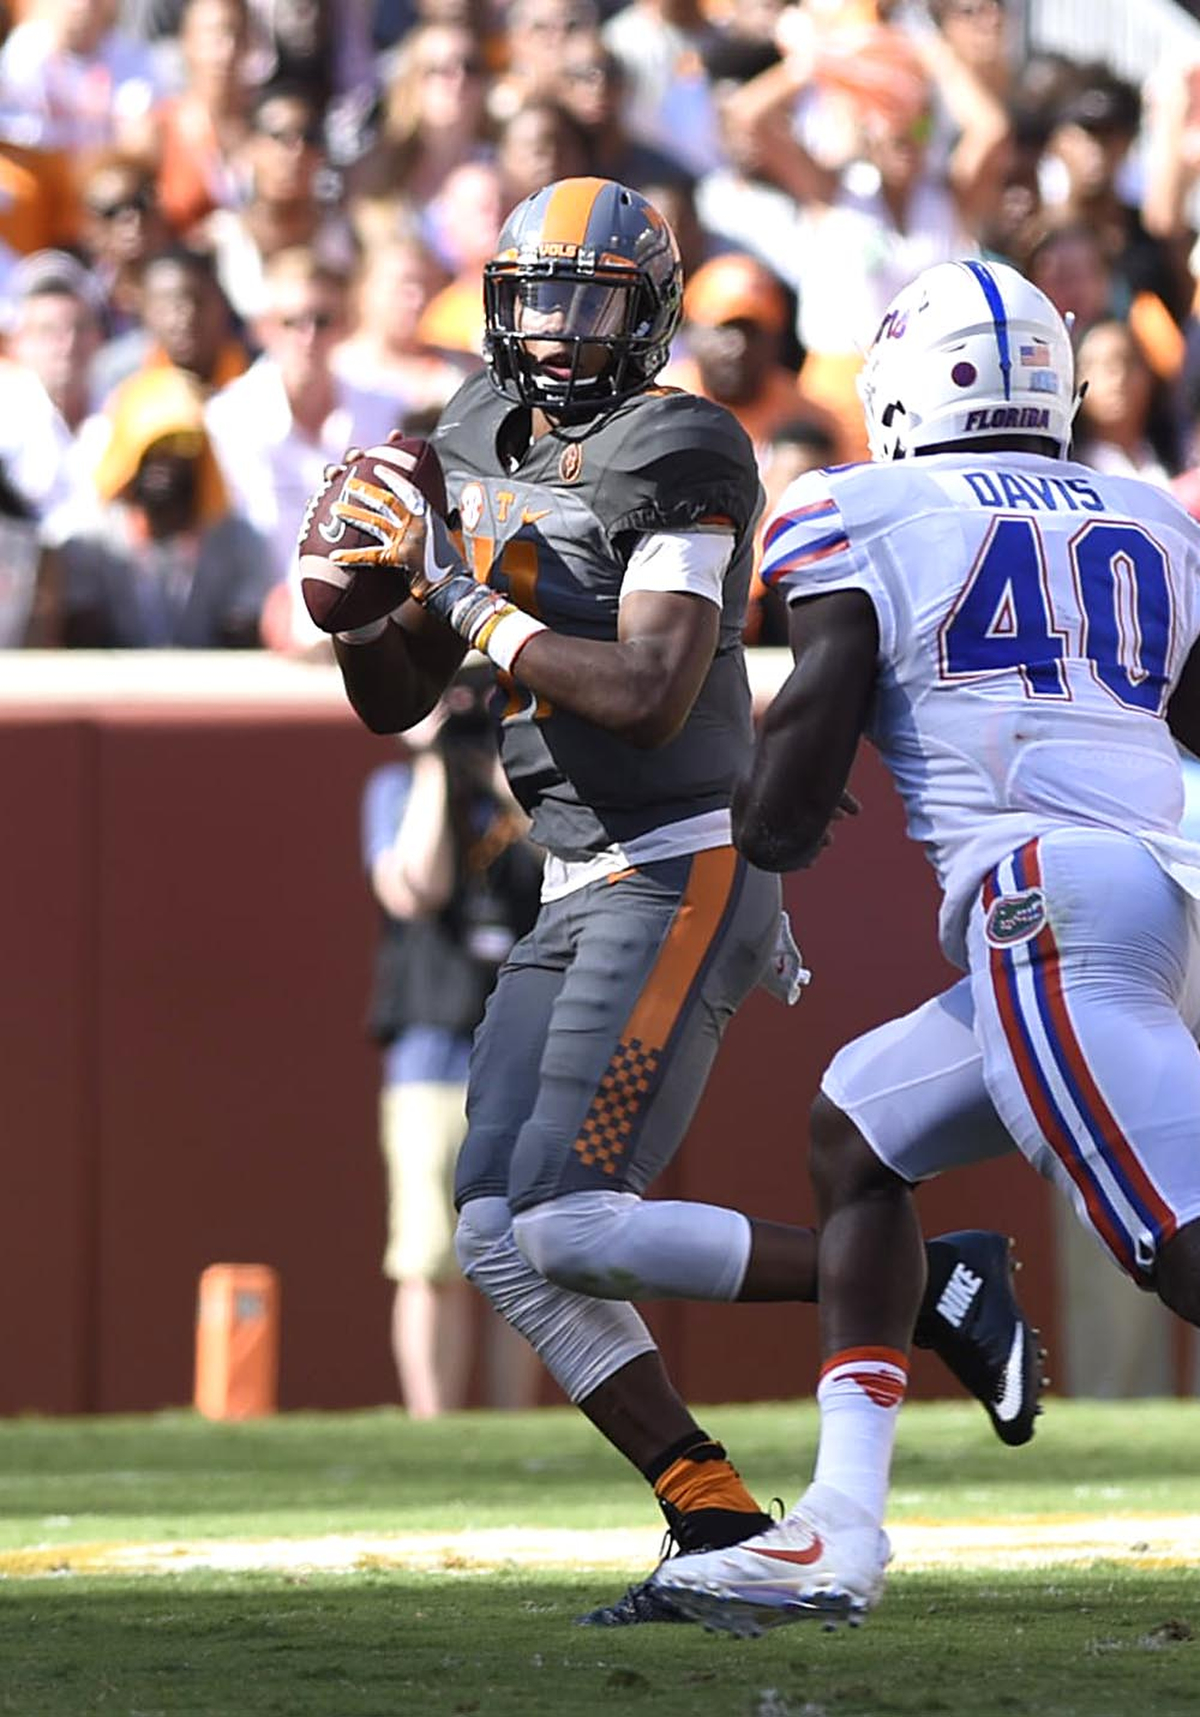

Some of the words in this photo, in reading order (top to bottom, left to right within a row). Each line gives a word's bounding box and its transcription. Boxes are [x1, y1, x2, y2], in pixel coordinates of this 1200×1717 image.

[538, 243, 577, 258] VOLS
[962, 406, 1050, 432] FLORIDA
[961, 472, 1105, 512] DAVIS
[936, 513, 1177, 719] 40
[935, 1261, 984, 1329] NIKE
